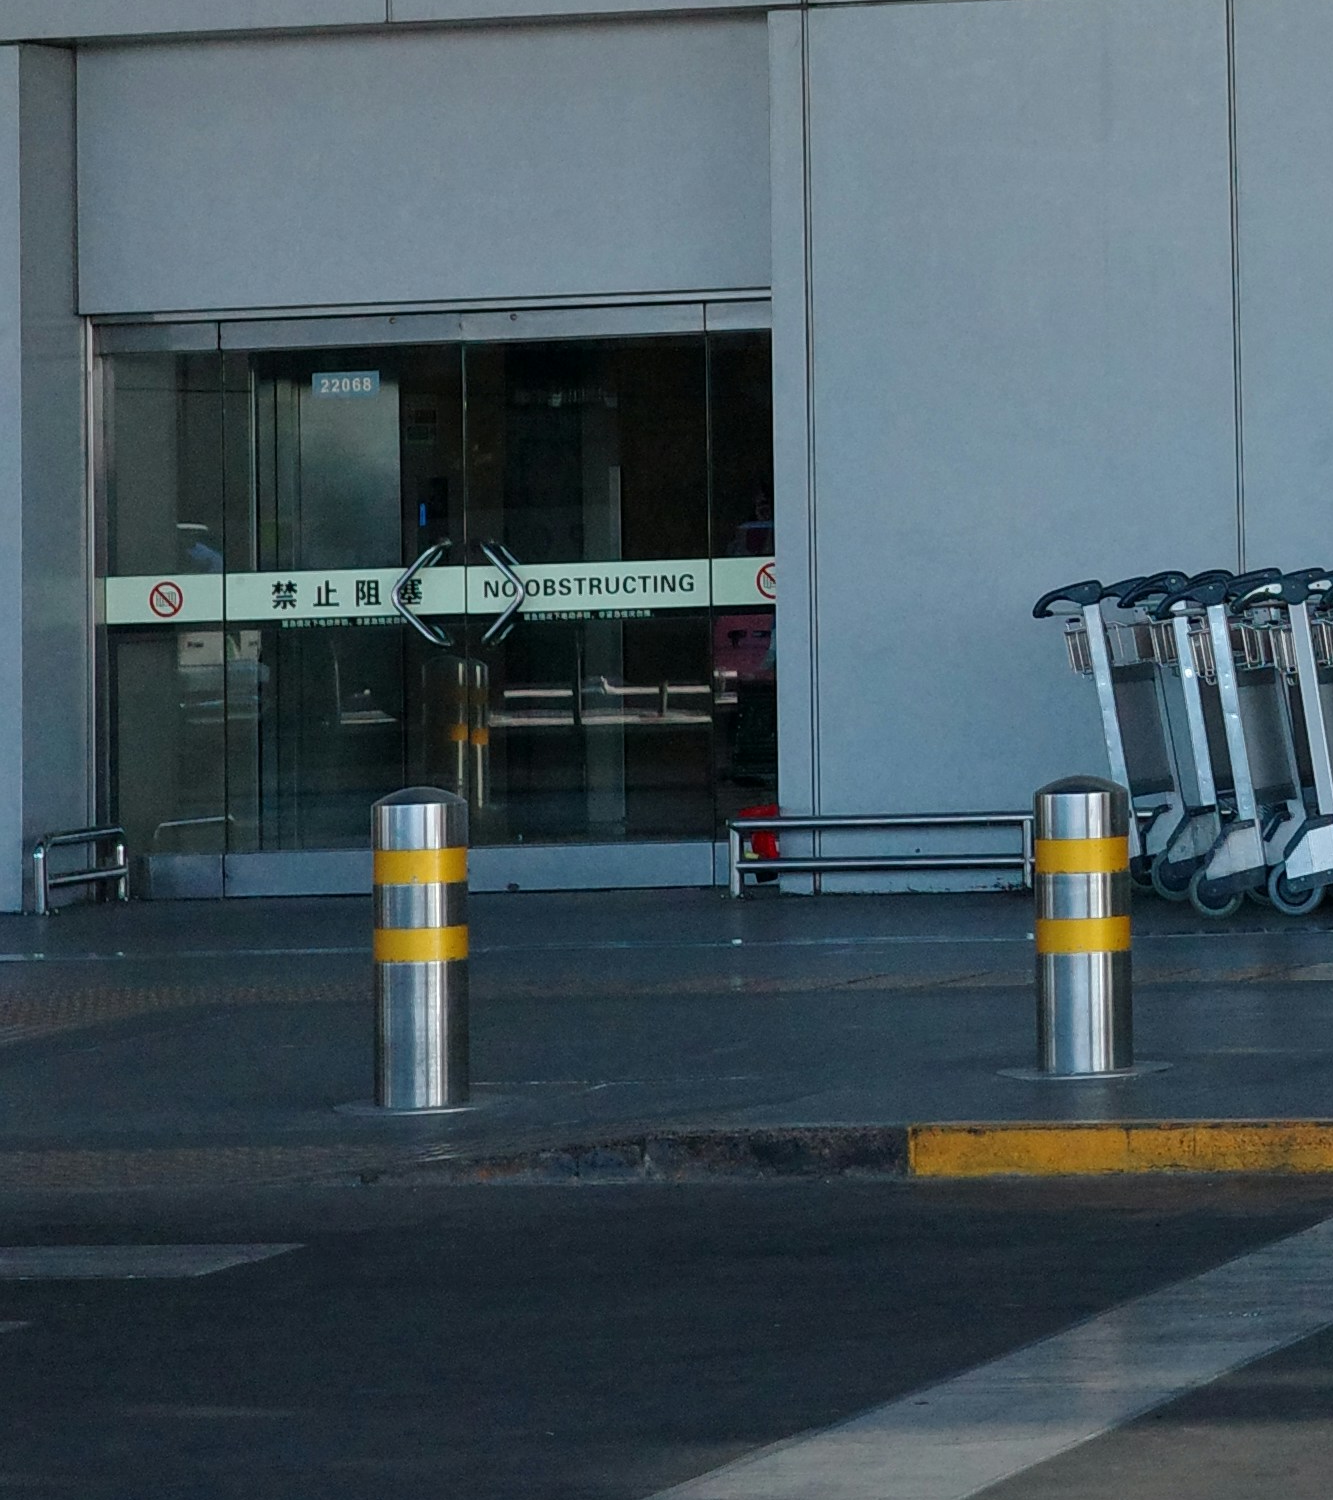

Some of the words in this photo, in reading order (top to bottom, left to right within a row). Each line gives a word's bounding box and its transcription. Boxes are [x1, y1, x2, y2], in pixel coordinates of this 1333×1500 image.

[320, 376, 372, 394] 22068
[271, 578, 424, 610] 禁止阻塞
[483, 579, 518, 599] NO
[524, 573, 695, 599] OBSTRUCTING
